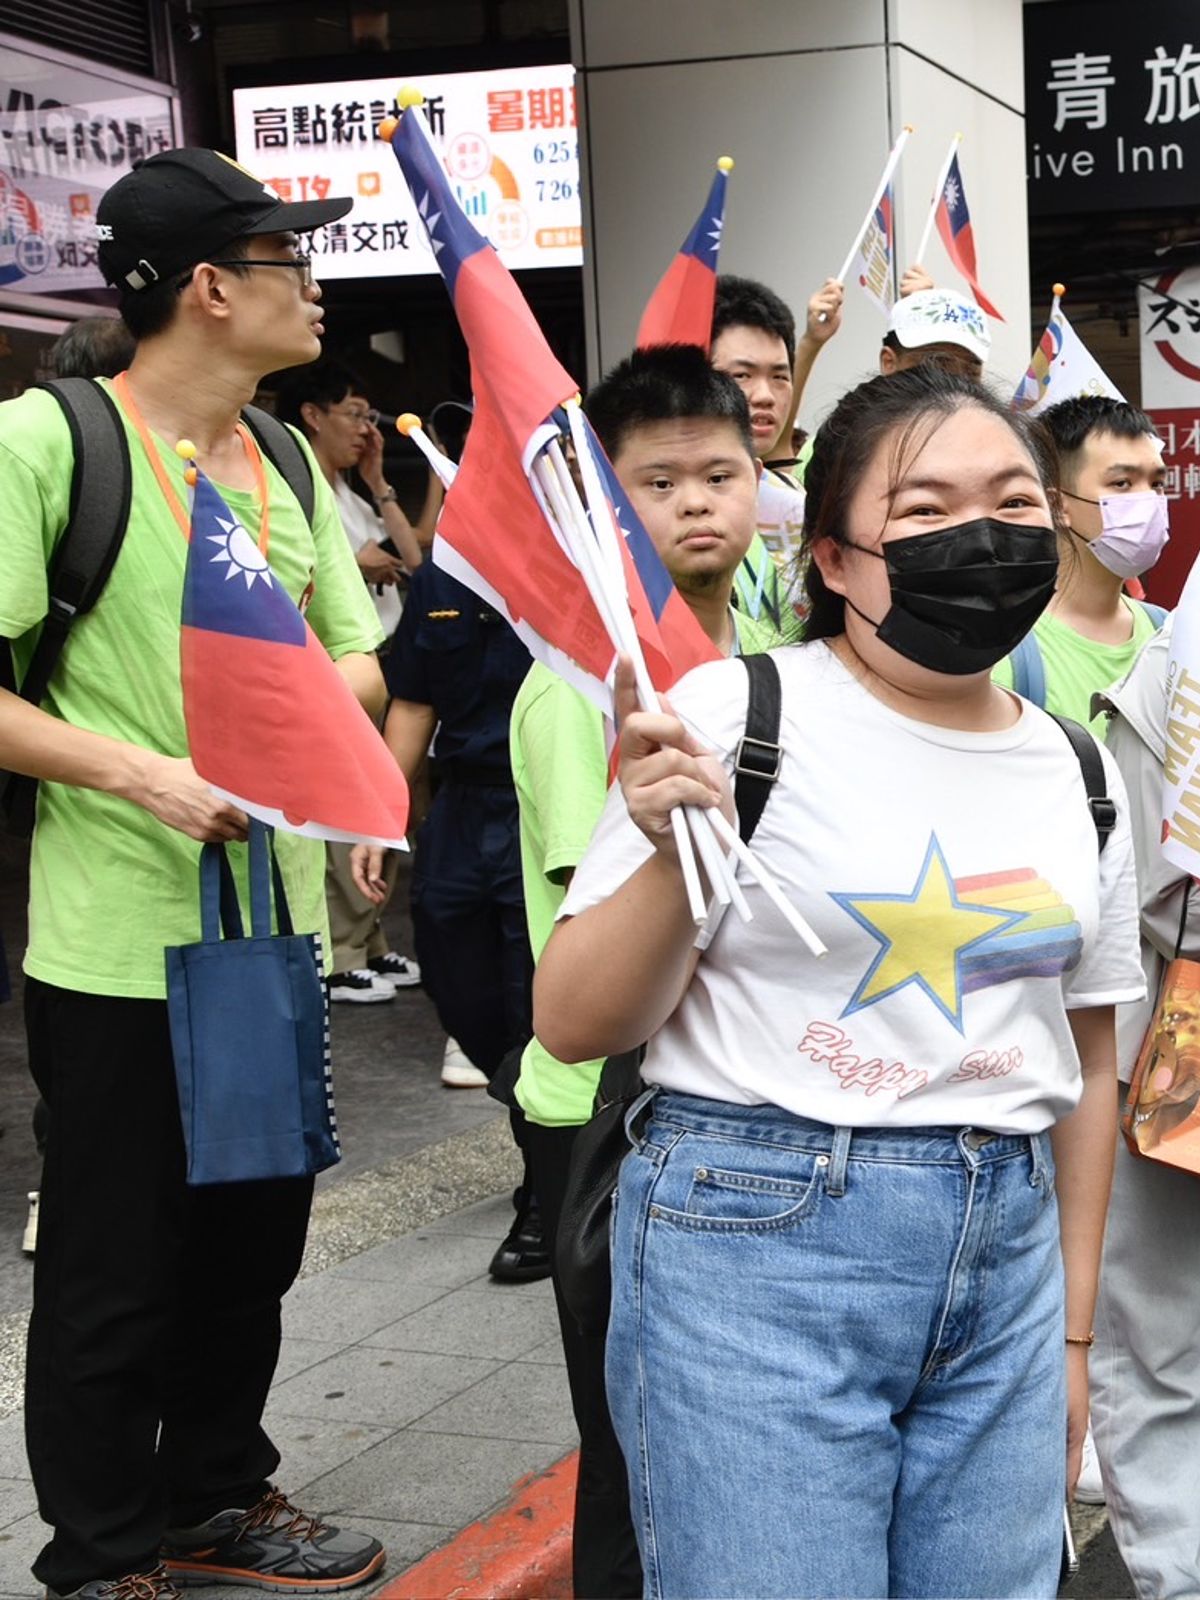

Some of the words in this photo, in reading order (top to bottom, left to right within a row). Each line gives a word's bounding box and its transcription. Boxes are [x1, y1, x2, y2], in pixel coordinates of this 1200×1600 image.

[1026, 143, 1095, 179] ive
[1117, 136, 1184, 173] Inn
[798, 1020, 929, 1101] Happy
[945, 1046, 1025, 1084] Star
